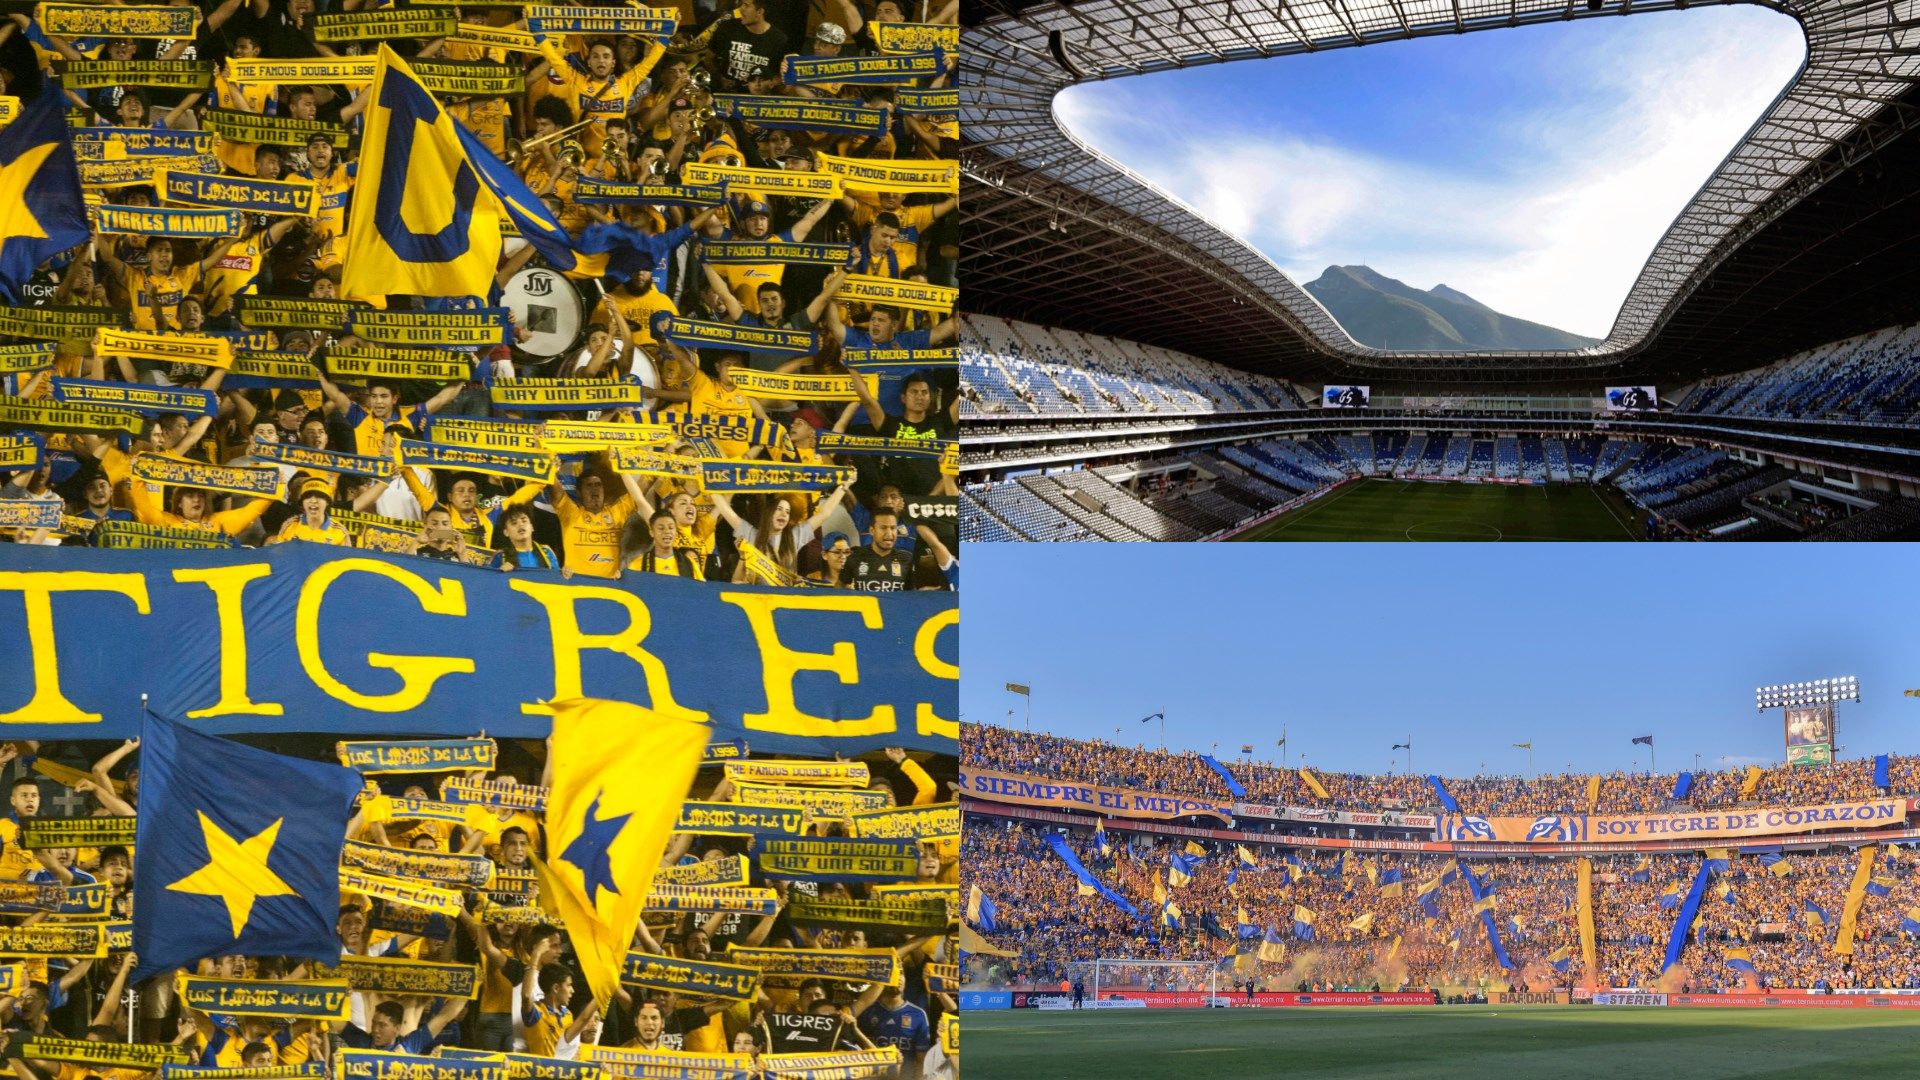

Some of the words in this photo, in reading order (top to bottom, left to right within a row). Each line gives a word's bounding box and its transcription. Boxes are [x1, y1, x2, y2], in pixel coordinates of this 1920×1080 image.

[532, 7, 671, 18] INCOMPARABLE
[328, 25, 358, 38] HAY
[366, 23, 397, 36] UNA
[404, 22, 445, 34] SOLA
[541, 20, 574, 30] HAY
[581, 20, 613, 30] UNA
[620, 20, 662, 31] SOLA
[731, 41, 752, 53] THE
[729, 50, 769, 66] FAMOUS
[237, 66, 255, 77] THE
[259, 66, 297, 77] FAMOUS
[301, 66, 340, 77] DOUBLE
[343, 66, 350, 76] L
[795, 66, 814, 80] THE
[817, 62, 855, 79] FAMOUS
[859, 59, 898, 75] DOUBLE
[911, 56, 936, 73] 1998
[158, 75, 199, 85] SOLA
[450, 79, 482, 92] UNA
[920, 94, 958, 106] FAMOUS
[759, 107, 798, 119] FAMOUS
[802, 109, 841, 121] DOUBLE
[855, 113, 879, 125] 1998
[193, 135, 212, 154] U
[690, 170, 708, 180] THE
[711, 172, 750, 184] FAMOUS
[754, 175, 793, 187] DOUBLE
[807, 178, 832, 189] 1998
[827, 162, 845, 173] THE
[848, 165, 886, 179] FAMOUS
[890, 170, 928, 184] DOUBLE
[169, 180, 194, 195] LOS
[294, 189, 313, 209] U
[599, 186, 639, 197] FAMOUS
[643, 186, 682, 198] DOUBLE
[101, 209, 163, 232] TIGRES
[169, 213, 228, 233] MANDA
[704, 245, 723, 257] THE
[726, 245, 766, 257] FAMOUS
[770, 246, 809, 259] DOUBLE
[823, 248, 849, 260] 1998
[855, 284, 893, 297] FAMOUS
[897, 287, 937, 302] DOUBLE
[355, 311, 500, 327] INCOMPARABLE
[366, 327, 399, 341] HAY
[411, 329, 442, 341] UNA
[448, 329, 490, 342] SOLA
[672, 322, 691, 334] THE
[694, 324, 733, 340] FAMOUS
[736, 330, 774, 344] DOUBLE
[787, 335, 811, 347] 1998
[846, 351, 866, 361] THE
[869, 349, 909, 361] FAMOUS
[913, 348, 952, 360] DOUBLE
[278, 362, 310, 376] UNA
[337, 358, 369, 371] HAY
[377, 360, 412, 374] UNA
[416, 362, 459, 376] SOLA
[729, 373, 749, 385] THE
[751, 376, 790, 390] FAMOUS
[793, 379, 830, 391] DOUBLE
[61, 386, 83, 398] THE
[86, 388, 124, 401] FAMOUS
[128, 391, 168, 404] DOUBLE
[181, 396, 207, 408] 1998
[504, 387, 538, 401] HAY
[546, 387, 580, 401] UNA
[586, 387, 628, 400] SOLA
[8, 407, 41, 422] HAY
[49, 409, 84, 425] UNA
[90, 412, 132, 428] SOLA
[446, 430, 480, 444] HAY
[486, 431, 519, 447] UNA
[559, 430, 596, 440] FAMOUS
[842, 436, 885, 447] FAMOUS
[533, 459, 551, 475] U
[350, 750, 376, 765] LOS
[473, 745, 490, 762] U
[711, 746, 739, 757] 1998
[728, 764, 745, 774] THE
[748, 764, 789, 776] FAMOUS
[792, 766, 831, 777] DOUBLE
[975, 776, 1095, 804] SIEMPRE
[1098, 792, 1130, 811] EL
[1244, 806, 1272, 816] TECATE
[1597, 819, 1641, 835] SOY
[1645, 815, 1721, 833] TIGRE
[1725, 811, 1760, 829] DE
[1766, 801, 1896, 826] CORAZÓN
[783, 815, 801, 833] U
[1352, 814, 1378, 824] TECATE
[1404, 816, 1432, 826] TECATE
[1243, 832, 1260, 841] THE
[1261, 833, 1289, 843] HOME
[1291, 835, 1320, 846] DEPOT
[1348, 840, 1366, 848] THE
[1369, 841, 1394, 849] HOME
[1396, 842, 1425, 851] DEPOT
[817, 857, 852, 870] UNA
[859, 859, 904, 872] SOLA
[87, 890, 105, 909] U
[737, 974, 756, 994] U
[188, 988, 215, 1002] LOS
[325, 992, 345, 1011] U
[1500, 992, 1558, 1004] BARDAHL
[1609, 993, 1662, 1005] STEREN
[772, 1013, 834, 1031] TIGRES
[347, 1061, 372, 1075] LOS
